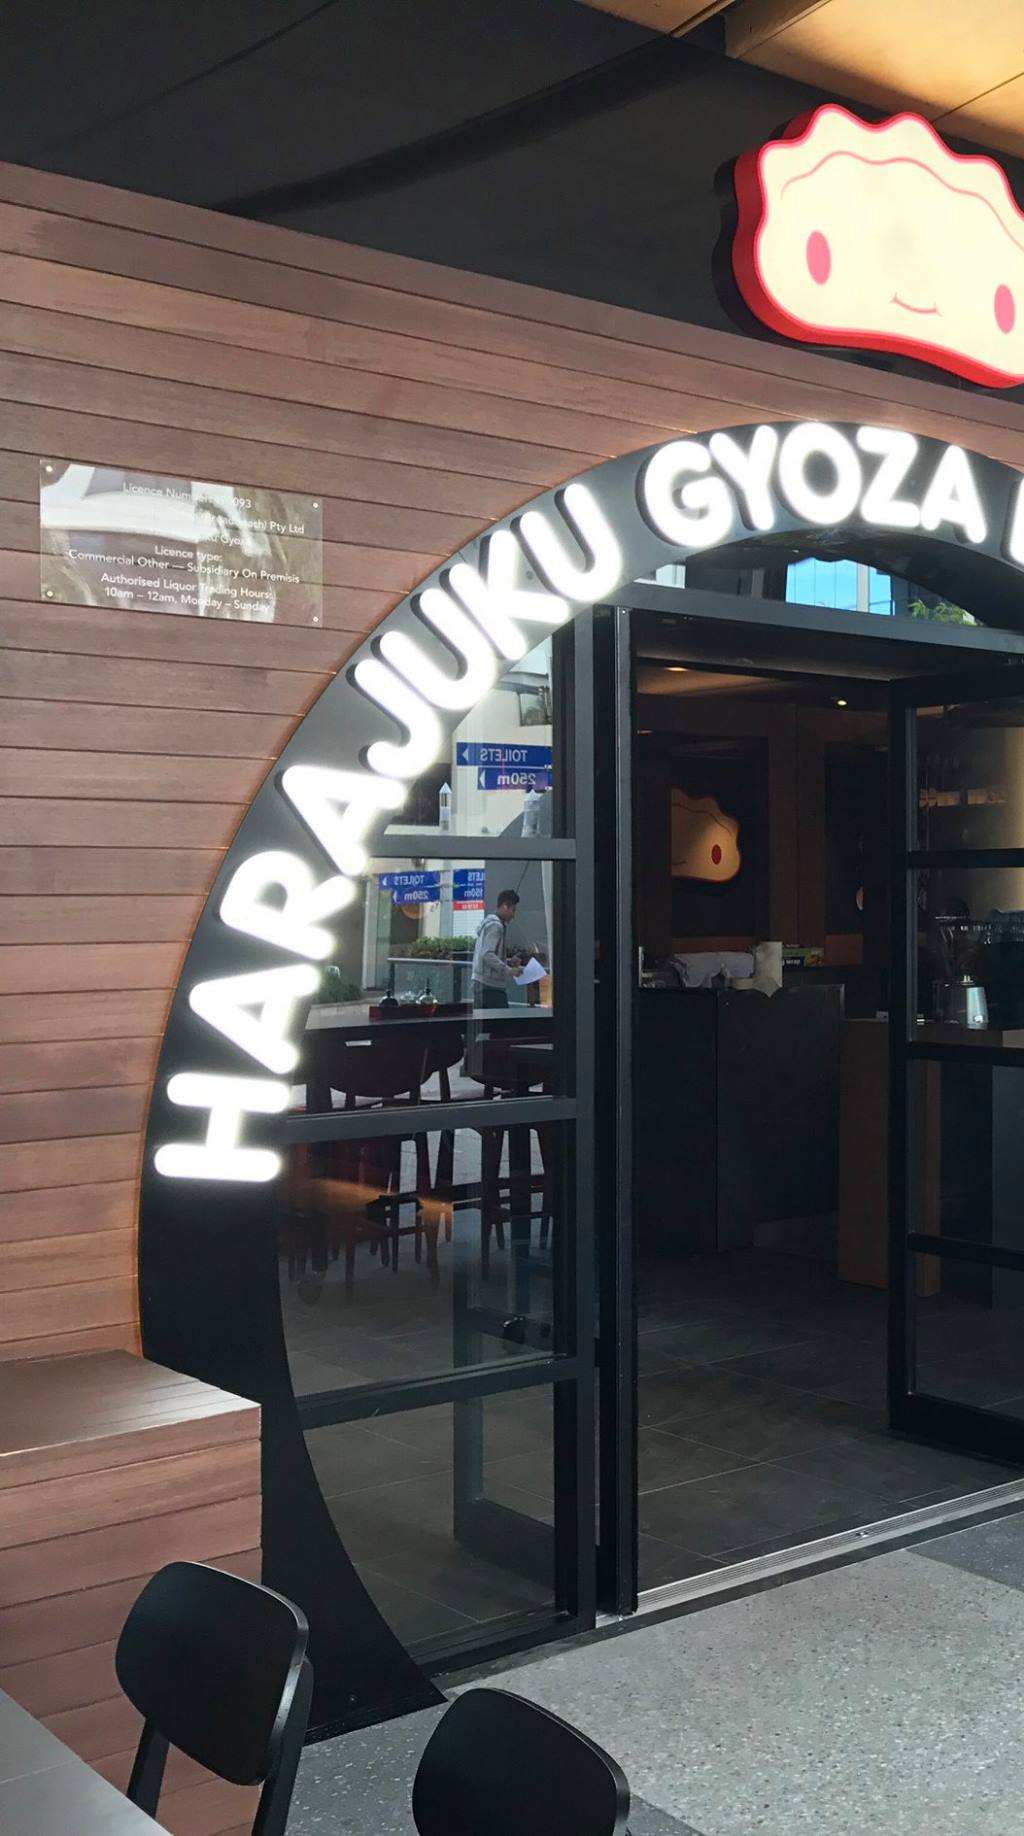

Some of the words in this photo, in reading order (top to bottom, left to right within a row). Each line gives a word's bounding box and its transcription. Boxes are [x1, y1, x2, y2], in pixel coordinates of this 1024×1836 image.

[123, 482, 163, 497] Licence
[270, 520, 287, 533] Pty
[288, 523, 305, 534] Ltd
[154, 545, 193, 558] Licence
[68, 549, 134, 566] Commercial
[137, 557, 170, 569] Other
[187, 562, 239, 579] Subsidiary
[242, 568, 257, 579] On
[101, 572, 160, 588] Authorised
[163, 579, 197, 593] Liquor
[104, 587, 134, 600] 10am
[180, 594, 223, 610] Monday
[154, 483, 623, 1182] HARAJUKU
[643, 421, 989, 549] GYOZA
